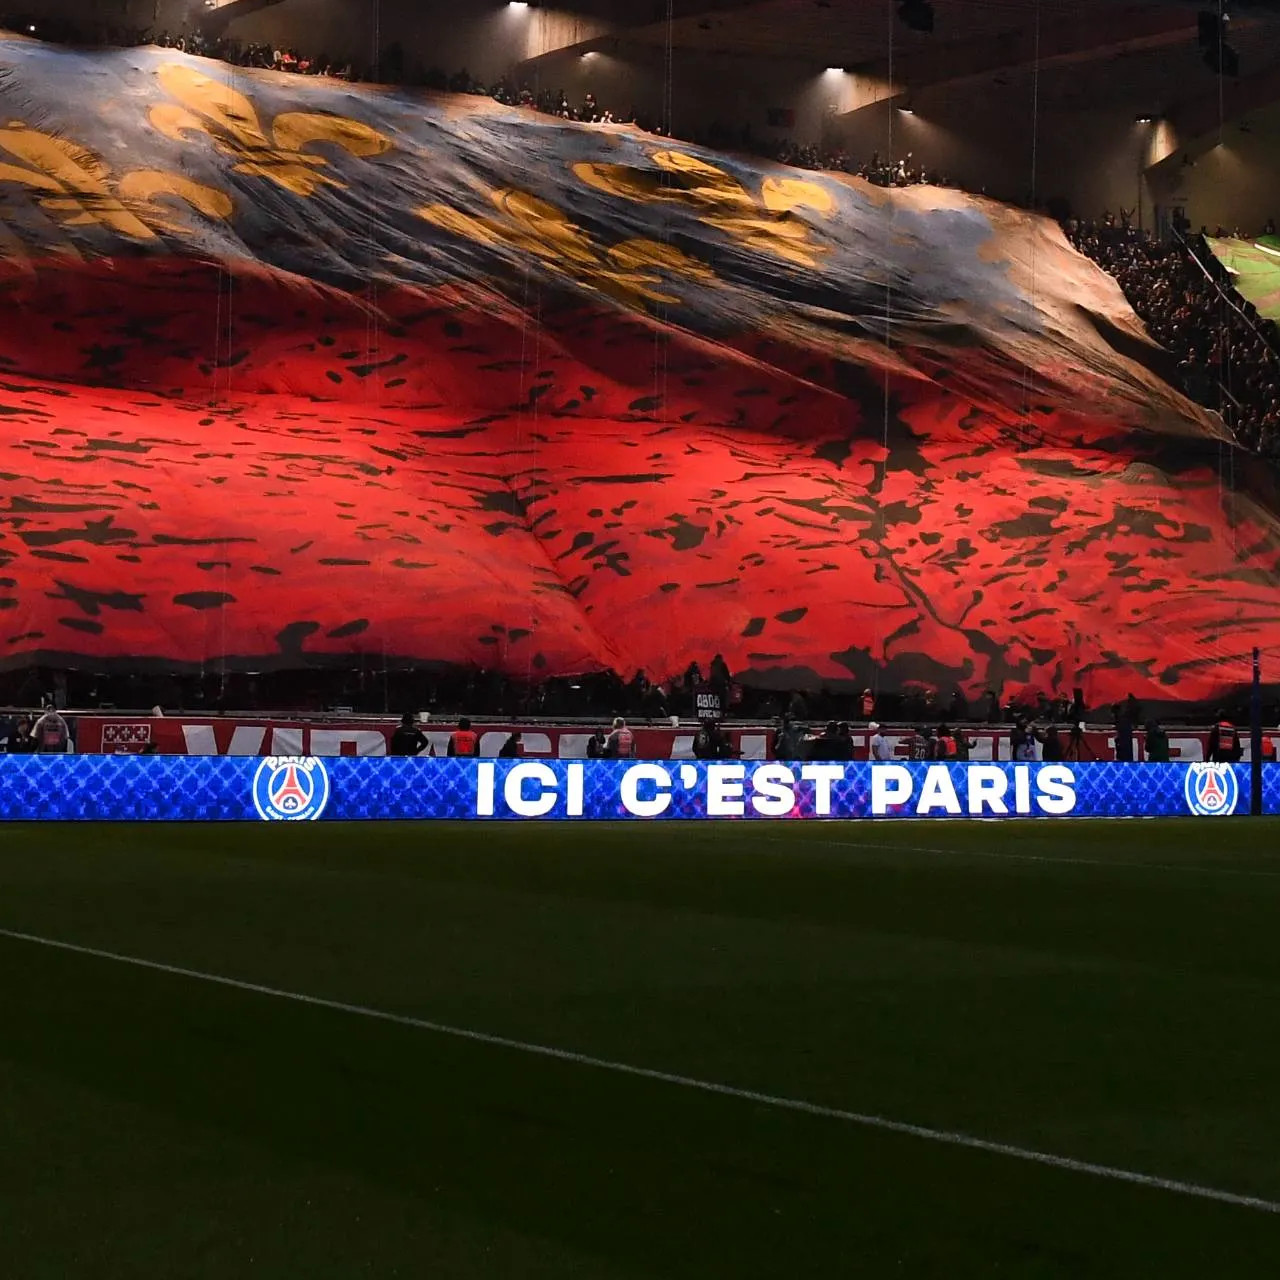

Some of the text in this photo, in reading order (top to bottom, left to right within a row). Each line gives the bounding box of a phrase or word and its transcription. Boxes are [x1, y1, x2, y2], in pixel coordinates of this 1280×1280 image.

[477, 762, 1076, 817] ICI C'EST PARIS
